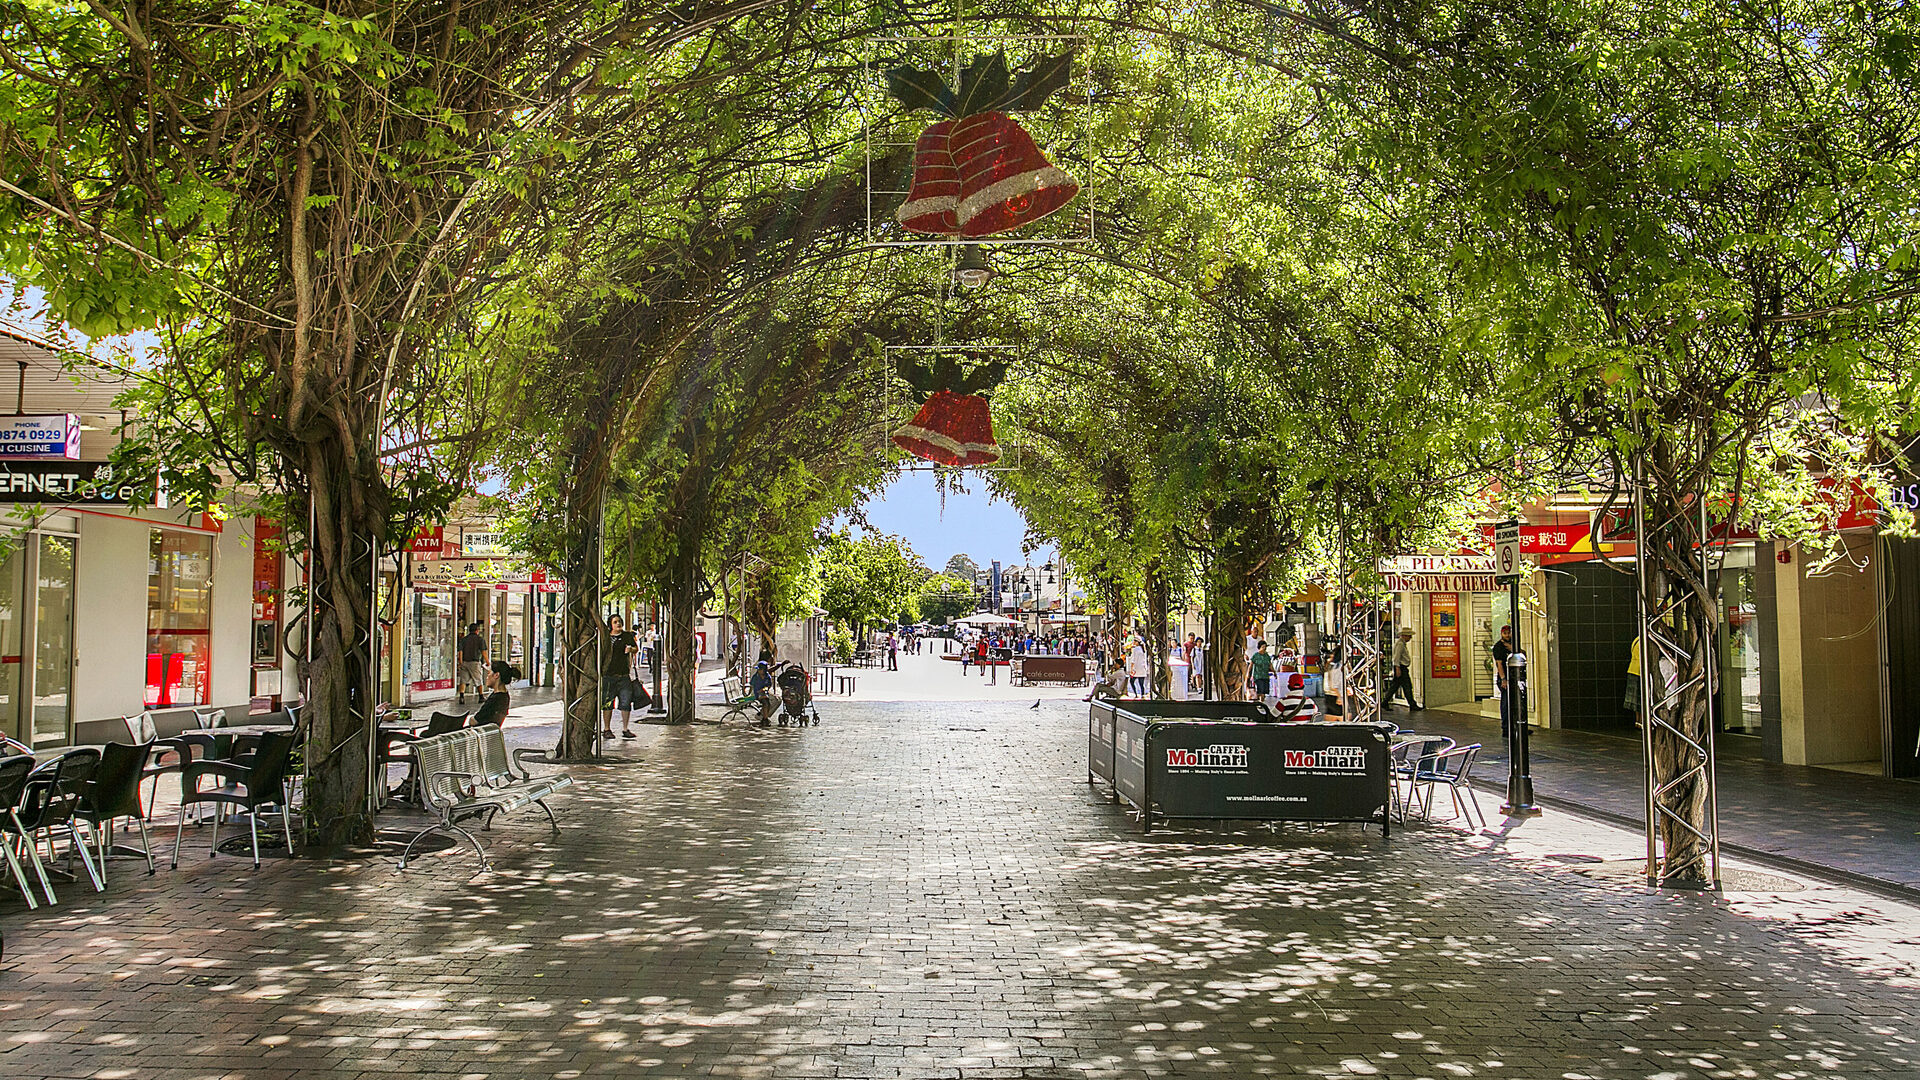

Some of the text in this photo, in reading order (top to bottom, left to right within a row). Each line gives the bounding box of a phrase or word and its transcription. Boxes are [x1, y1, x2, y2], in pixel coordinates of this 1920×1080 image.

[29, 430, 61, 440] 0929
[7, 444, 51, 453] CUISINE
[414, 538, 440, 547] ATM
[1387, 575, 1450, 591] DISCOUNT
[1167, 749, 1248, 767] Molinari
[1285, 750, 1366, 769] Molinari
